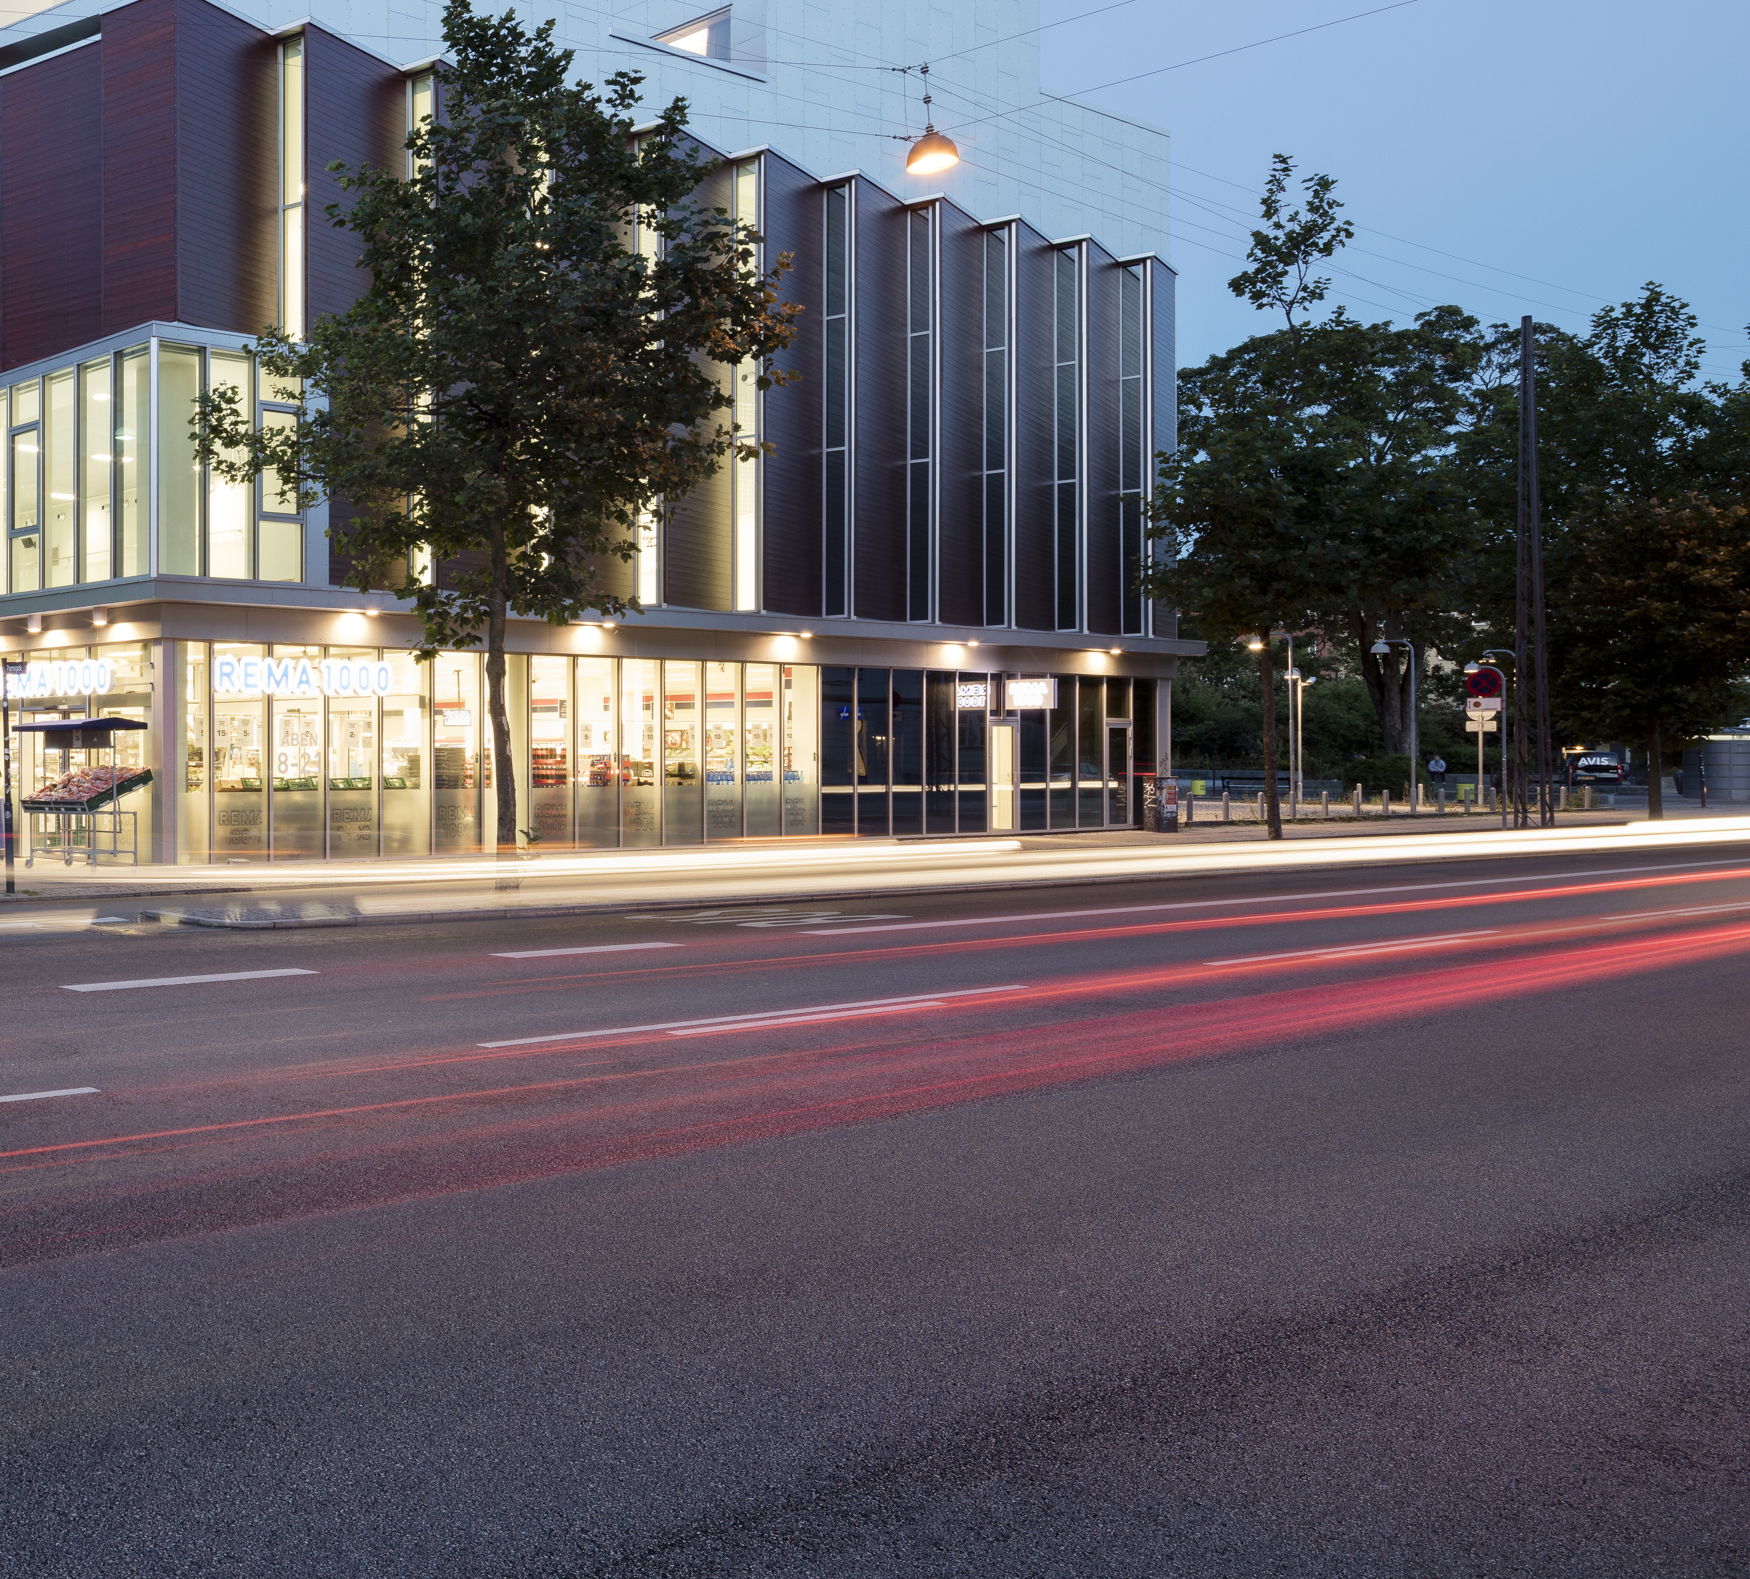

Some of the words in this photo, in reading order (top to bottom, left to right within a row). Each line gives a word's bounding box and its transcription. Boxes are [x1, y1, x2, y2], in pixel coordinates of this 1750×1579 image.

[55, 662, 110, 692] 1000
[217, 659, 313, 691] REMA
[323, 662, 391, 693] 1000
[1578, 757, 1609, 767] AVIS
